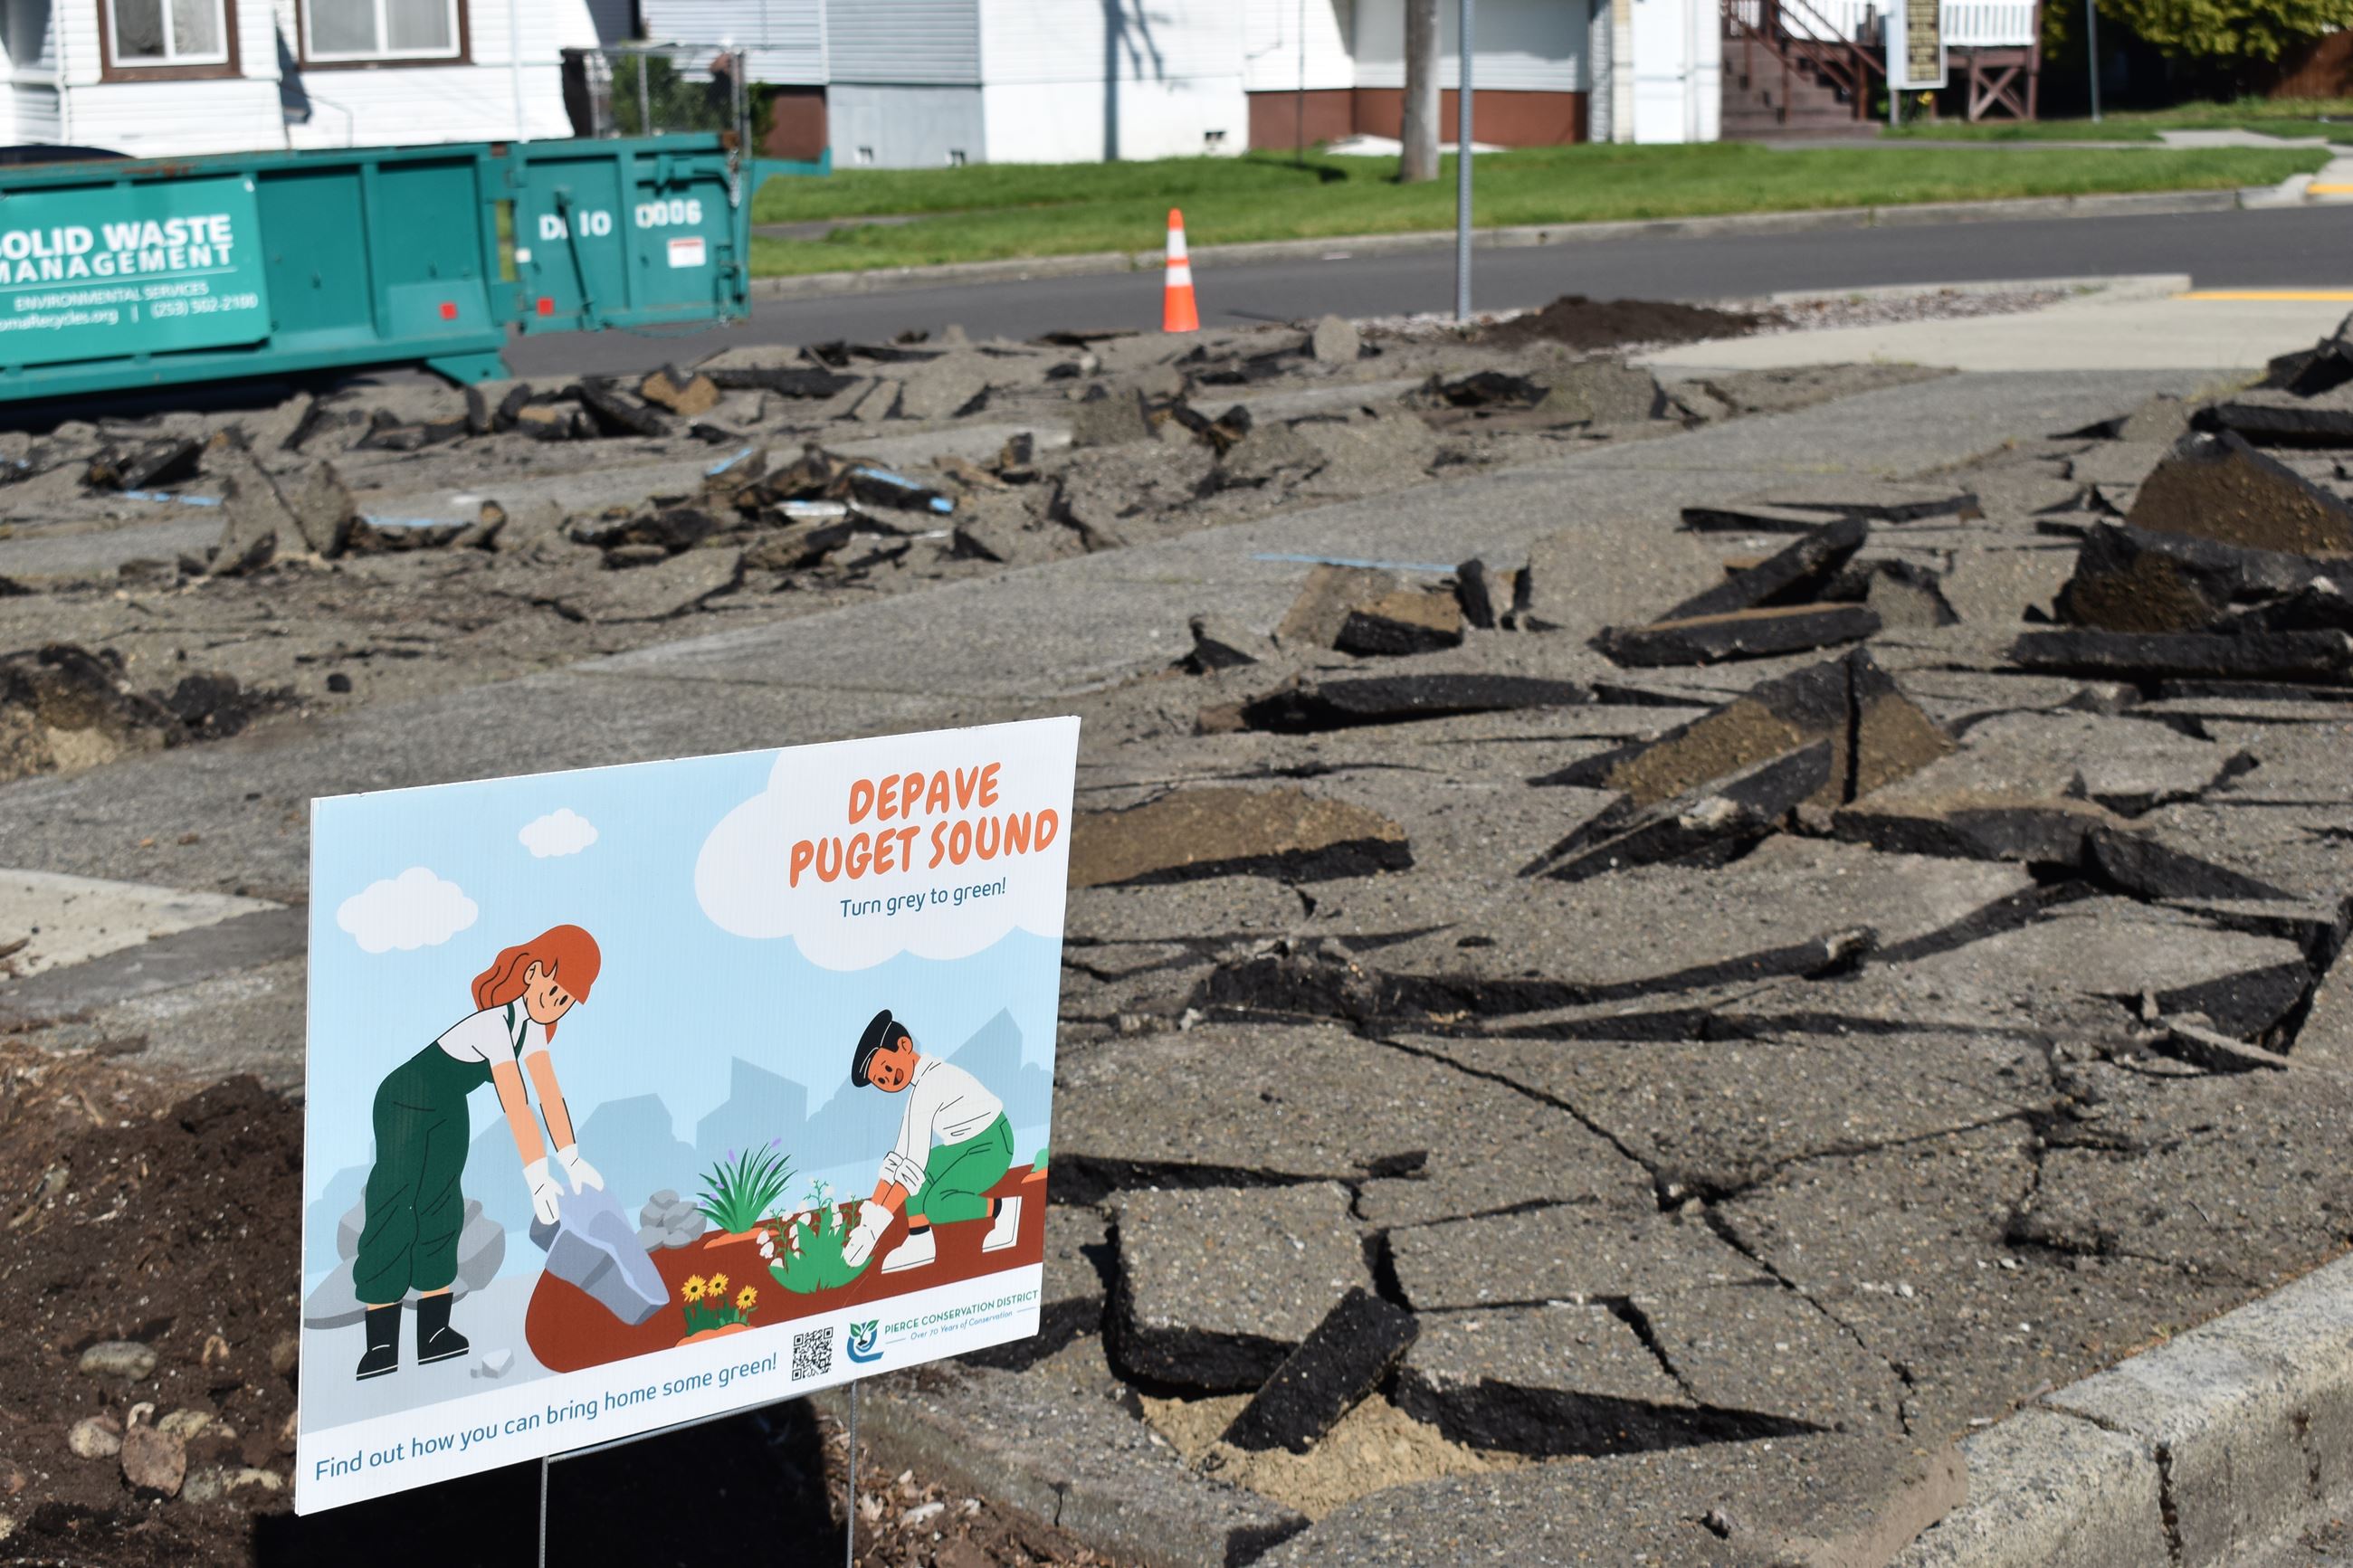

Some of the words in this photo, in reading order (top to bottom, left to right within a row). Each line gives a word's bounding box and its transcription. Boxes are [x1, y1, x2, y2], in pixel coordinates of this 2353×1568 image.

[0, 225, 94, 261] OLID
[101, 214, 233, 252] WASTE
[14, 286, 142, 312] ENVIRONMENTAL
[143, 280, 209, 300] SERVICES
[848, 762, 1001, 824] DEPAVE
[789, 825, 920, 889] PUGET
[929, 808, 1059, 870] SOUND
[840, 898, 881, 918] Turn
[886, 892, 926, 917] grey
[930, 888, 948, 904] to
[953, 877, 1006, 907] green!
[884, 1318, 919, 1335] PIERCE
[921, 1300, 995, 1326] CONSERVATION
[996, 1289, 1038, 1308] DISTRICT
[910, 1331, 928, 1341] Over
[929, 1329, 938, 1338] 70
[940, 1324, 958, 1334] Years
[959, 1319, 968, 1330] of
[968, 1310, 1013, 1326] Conservation
[316, 1449, 362, 1480] Find
[369, 1443, 405, 1467] out
[412, 1434, 454, 1458] how
[460, 1423, 497, 1451] you
[504, 1413, 540, 1434] can
[547, 1400, 598, 1424] bring
[605, 1385, 657, 1411] home
[662, 1373, 712, 1396] some
[719, 1352, 777, 1388] green!
